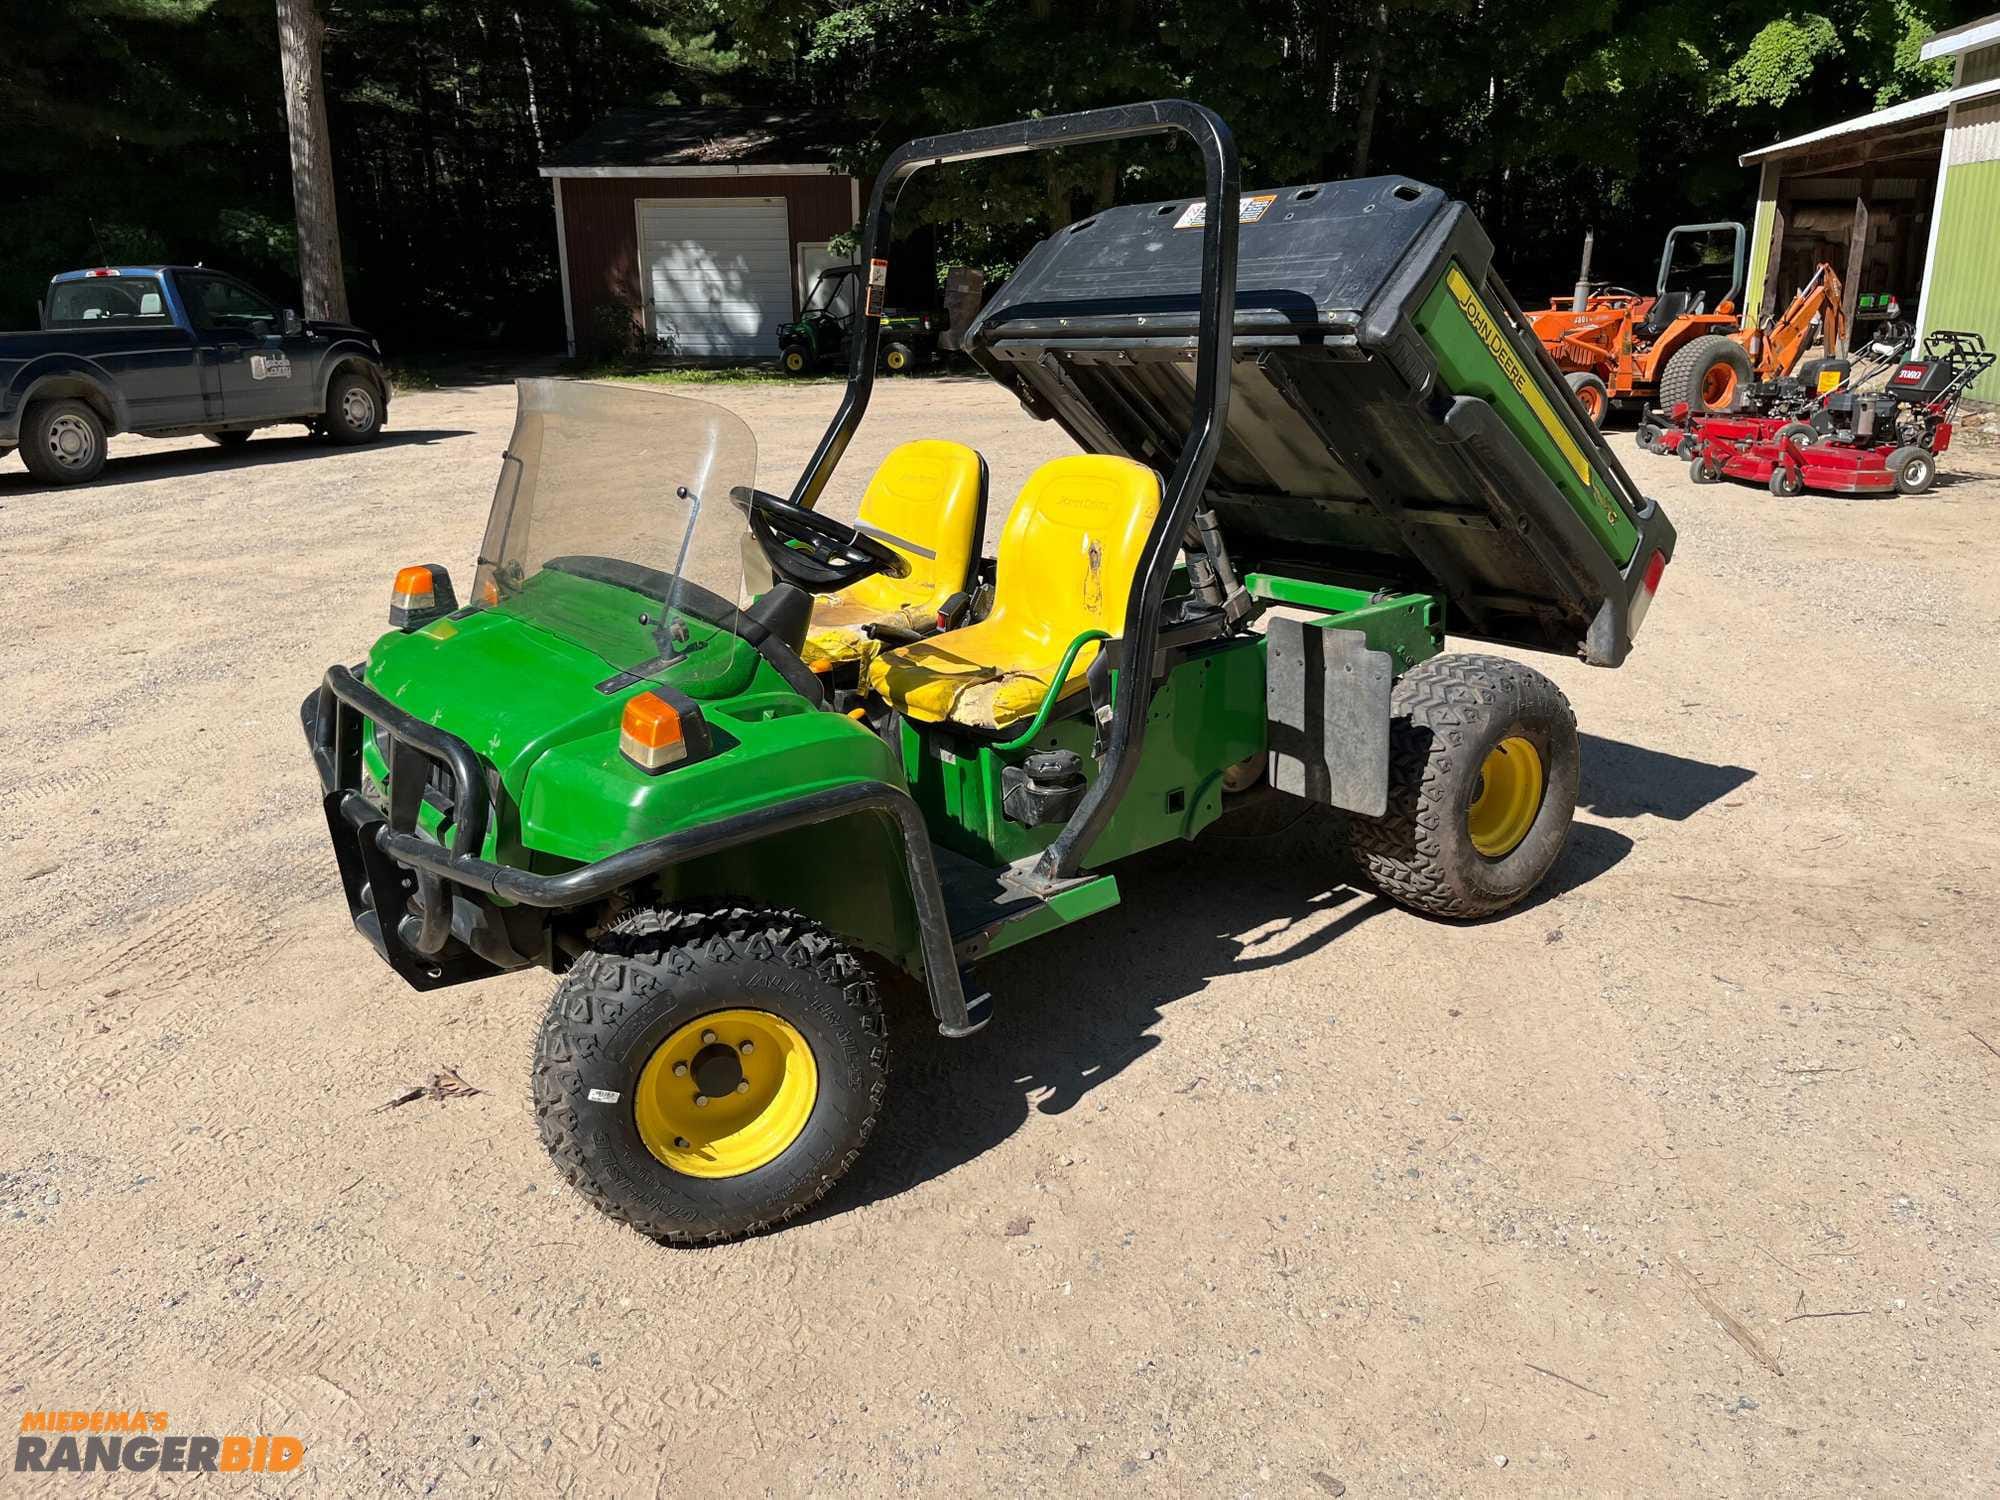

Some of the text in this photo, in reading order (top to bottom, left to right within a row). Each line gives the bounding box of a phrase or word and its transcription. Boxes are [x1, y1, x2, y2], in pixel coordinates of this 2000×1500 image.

[1460, 295, 1526, 391] JOHN DEERE
[1898, 369, 1922, 379] TORO
